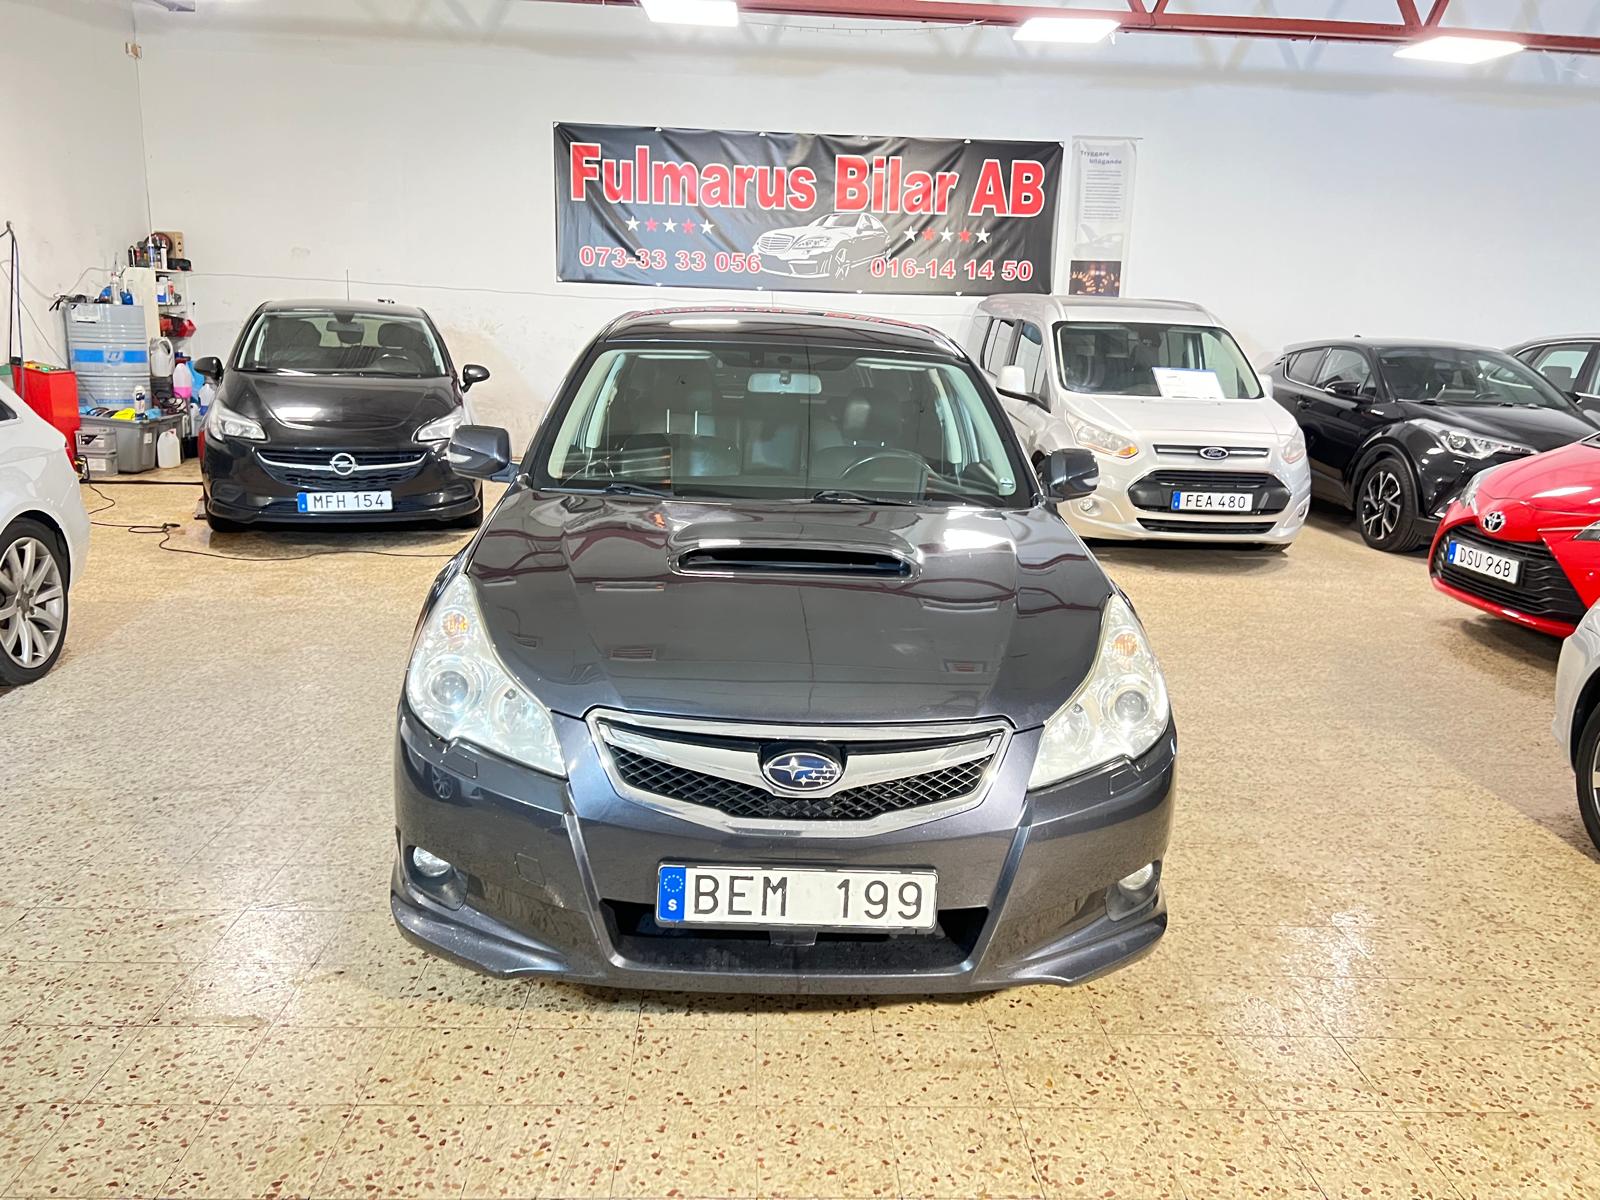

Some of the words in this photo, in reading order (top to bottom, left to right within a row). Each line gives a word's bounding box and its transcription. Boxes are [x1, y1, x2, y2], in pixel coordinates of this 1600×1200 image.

[570, 141, 817, 211] Fulmarus
[834, 154, 960, 215] Bilar
[968, 158, 1045, 217] AB
[579, 246, 667, 270] 073-33
[675, 250, 706, 272] 33
[714, 252, 761, 273] 056
[871, 257, 956, 280] 016-14
[964, 259, 994, 280] 14
[1002, 260, 1033, 281] 50
[313, 494, 346, 509] MFH
[353, 494, 384, 508] 154
[1186, 494, 1213, 508] FEA
[1218, 495, 1246, 509] 480
[1459, 547, 1482, 568] DSU
[1485, 556, 1511, 578] 96B
[667, 898, 677, 911] S
[694, 874, 788, 917] BEM
[836, 878, 923, 920] 199
